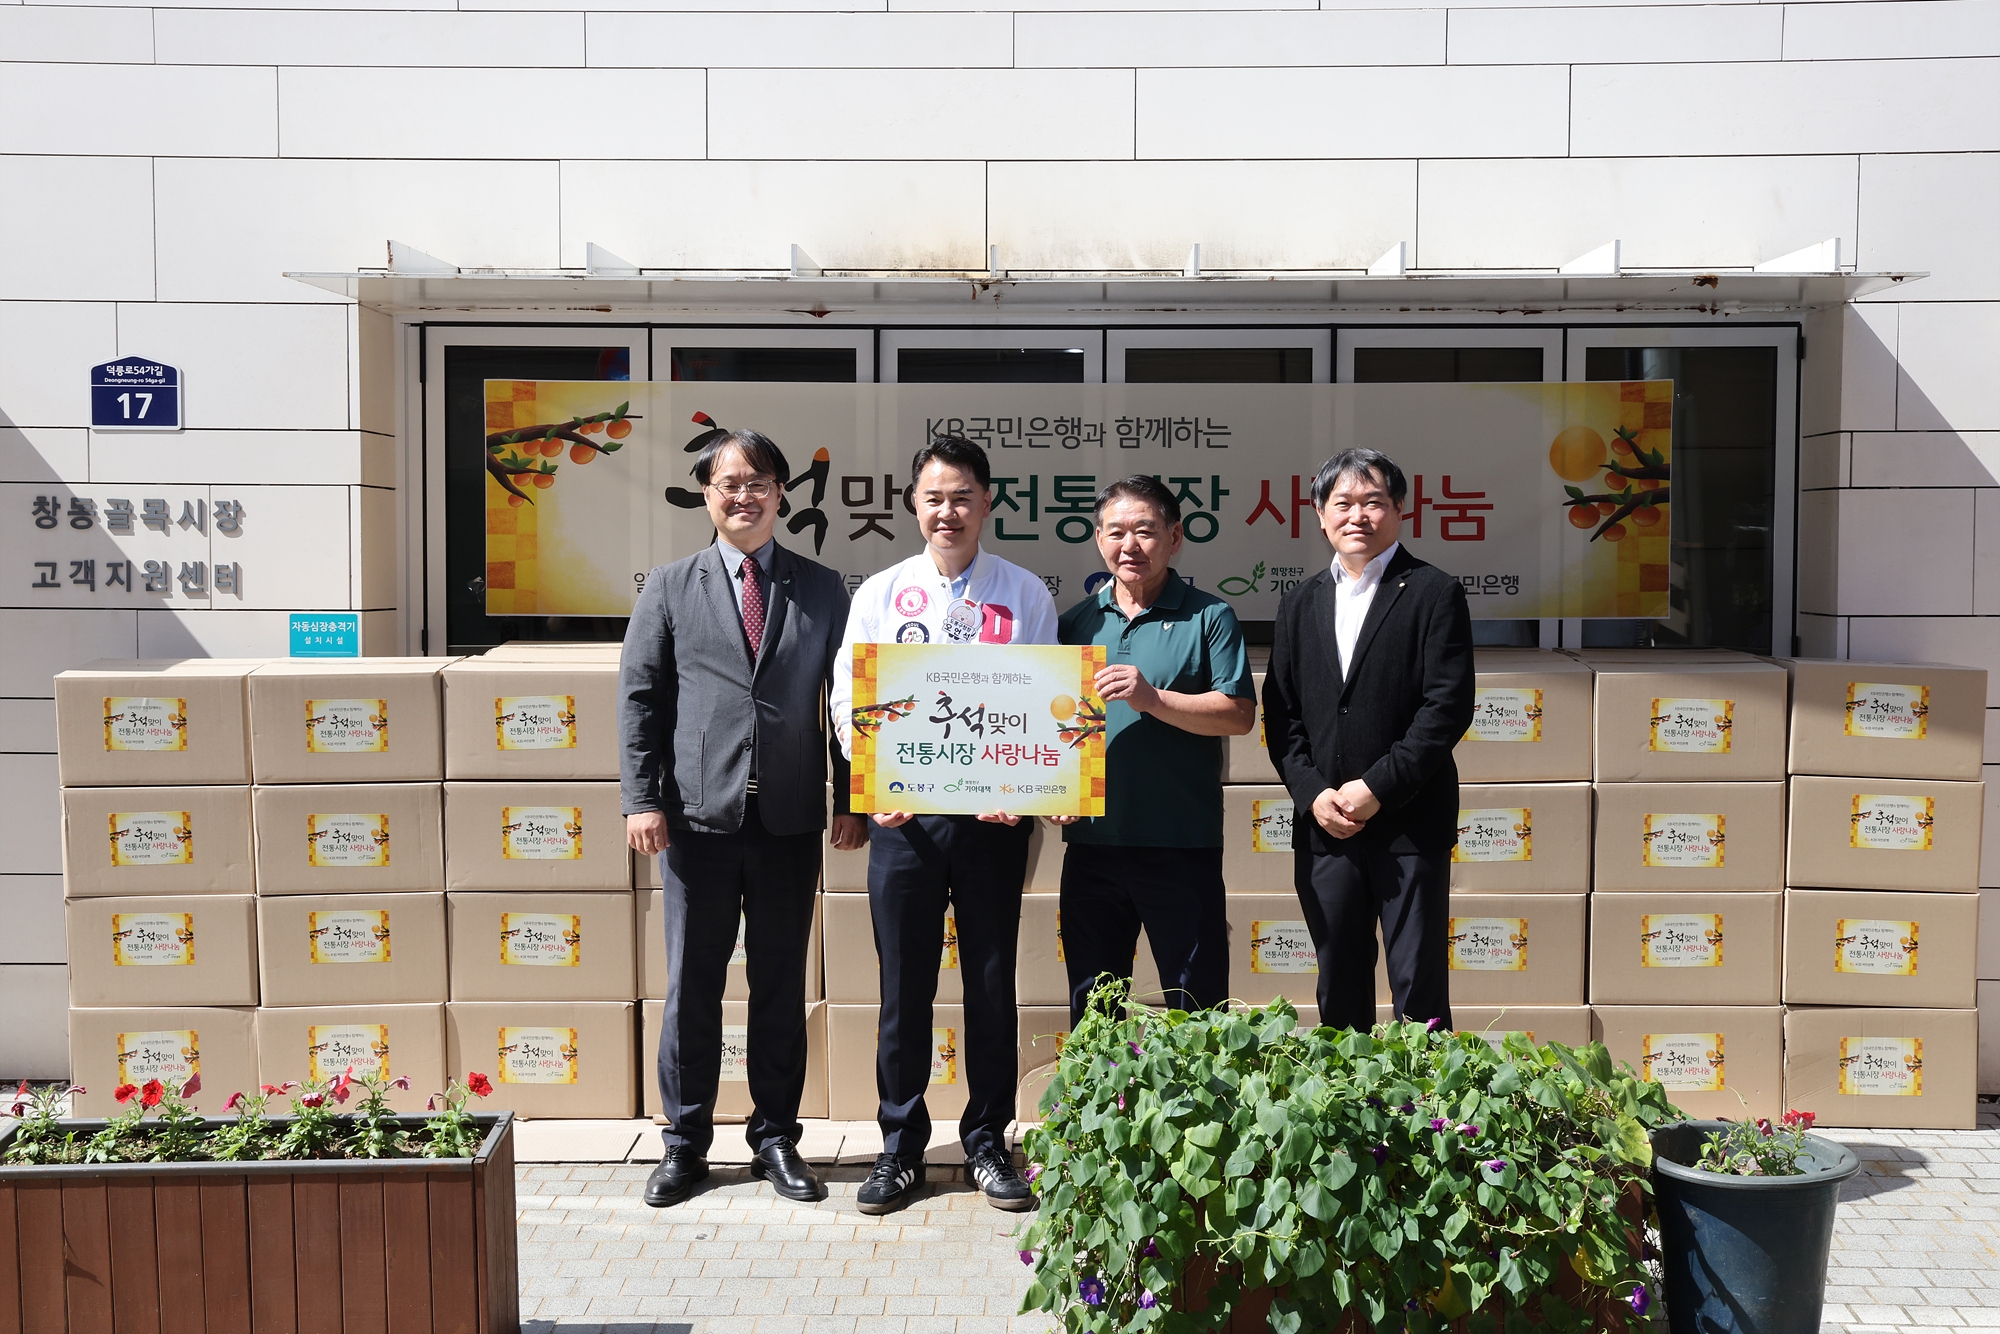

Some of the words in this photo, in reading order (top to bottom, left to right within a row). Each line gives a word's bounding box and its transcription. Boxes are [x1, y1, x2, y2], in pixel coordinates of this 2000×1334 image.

[106, 366, 163, 376] 덕릉로54가길
[117, 393, 153, 419] 17
[926, 416, 1106, 450] KB국민은행과
[1115, 416, 1231, 449] 함께하는
[32, 496, 241, 532] 창동골목시장
[989, 475, 1230, 543] 전통장
[1245, 475, 1494, 541] 사나눔
[32, 560, 238, 594] 고객지원센터
[1271, 567, 1304, 577] 희망친구
[292, 622, 356, 632] 자동심장충격기
[926, 672, 989, 684] KB국민은행과
[992, 672, 1032, 684] 함께하는
[1485, 702, 1517, 718] 추석맞이
[1870, 698, 1903, 714] 추석맞이
[128, 711, 161, 727] 추석맞이
[329, 713, 363, 729] 추석맞이
[518, 710, 551, 726] 추석맞이
[929, 690, 1027, 740] 추석맞이
[1474, 718, 1500, 726] 전통시장
[1674, 713, 1707, 729] 추석맞이
[1858, 713, 1885, 722] 전통시장
[1886, 715, 1913, 724] 사랑나눔
[146, 728, 172, 736] 사랑나눔
[320, 730, 346, 738] 전통시장
[347, 729, 373, 737] 사랑나눔
[509, 726, 535, 735] 전통시장
[536, 726, 562, 734] 사랑나눔
[1663, 729, 1689, 737] 전통시장
[1691, 730, 1717, 738] 사랑나눔
[896, 742, 976, 766] 전통시장
[981, 744, 1061, 766] 사랑나눔
[908, 784, 935, 792] 도봉구
[1018, 786, 1033, 794] KB
[1035, 785, 1066, 794] 국민은행
[1875, 809, 1908, 825] 추석맞이
[133, 825, 167, 842] 추석맞이
[331, 828, 364, 843] 추석맞이
[525, 821, 557, 836] 추석맞이
[1474, 822, 1507, 839] 추석맞이
[1667, 828, 1699, 843] 추석맞이
[1864, 825, 1890, 834] 전통시장
[1892, 827, 1918, 835] 사랑나눔
[124, 842, 150, 851] 전통시장
[151, 841, 178, 850] 사랑나눔
[322, 844, 347, 852] 전통시장
[349, 844, 375, 852] 사랑나눔
[1464, 839, 1490, 848] 전통시장
[1491, 838, 1517, 847] 사랑나눔
[1657, 844, 1682, 852] 전통시장
[136, 927, 169, 942] 추석맞이
[332, 924, 365, 940] 추석맞이
[524, 927, 555, 943] 추석맞이
[1471, 932, 1502, 947] 추석맞이
[1665, 928, 1698, 944] 추석맞이
[126, 943, 152, 951] 전통시장
[154, 943, 179, 951] 사랑나눔
[323, 940, 349, 949] 전통시장
[350, 940, 376, 948] 사랑나눔
[514, 943, 539, 951] 전통시장
[1274, 935, 1306, 950] 추석맞이
[1655, 944, 1680, 953] 전통시장
[1682, 944, 1708, 952] 사랑나눔
[1860, 934, 1893, 950] 추석맞이
[1461, 947, 1485, 955] 전통시장
[1487, 948, 1512, 956] 사랑나눔
[1849, 950, 1875, 958] 전통시장
[1877, 951, 1902, 959] 사랑나눔
[141, 1046, 175, 1064] 추석맞이
[332, 1039, 364, 1057] 추석맞이
[521, 1042, 553, 1058] 추석맞이
[322, 1057, 348, 1066] 전통시장
[349, 1057, 375, 1065] 사랑나눔
[511, 1059, 536, 1068] 전통시장
[538, 1060, 563, 1068] 사랑나눔
[1666, 1049, 1699, 1066] 추석맞이
[1863, 1053, 1896, 1069] 추석맞이
[132, 1064, 158, 1073] 전통시장
[159, 1063, 185, 1072] 사랑나눔
[1656, 1067, 1682, 1076] 전통시장
[1684, 1066, 1710, 1075] 사랑나눔
[1853, 1070, 1879, 1079] 전통시장
[1881, 1071, 1907, 1079] 사랑나눔
